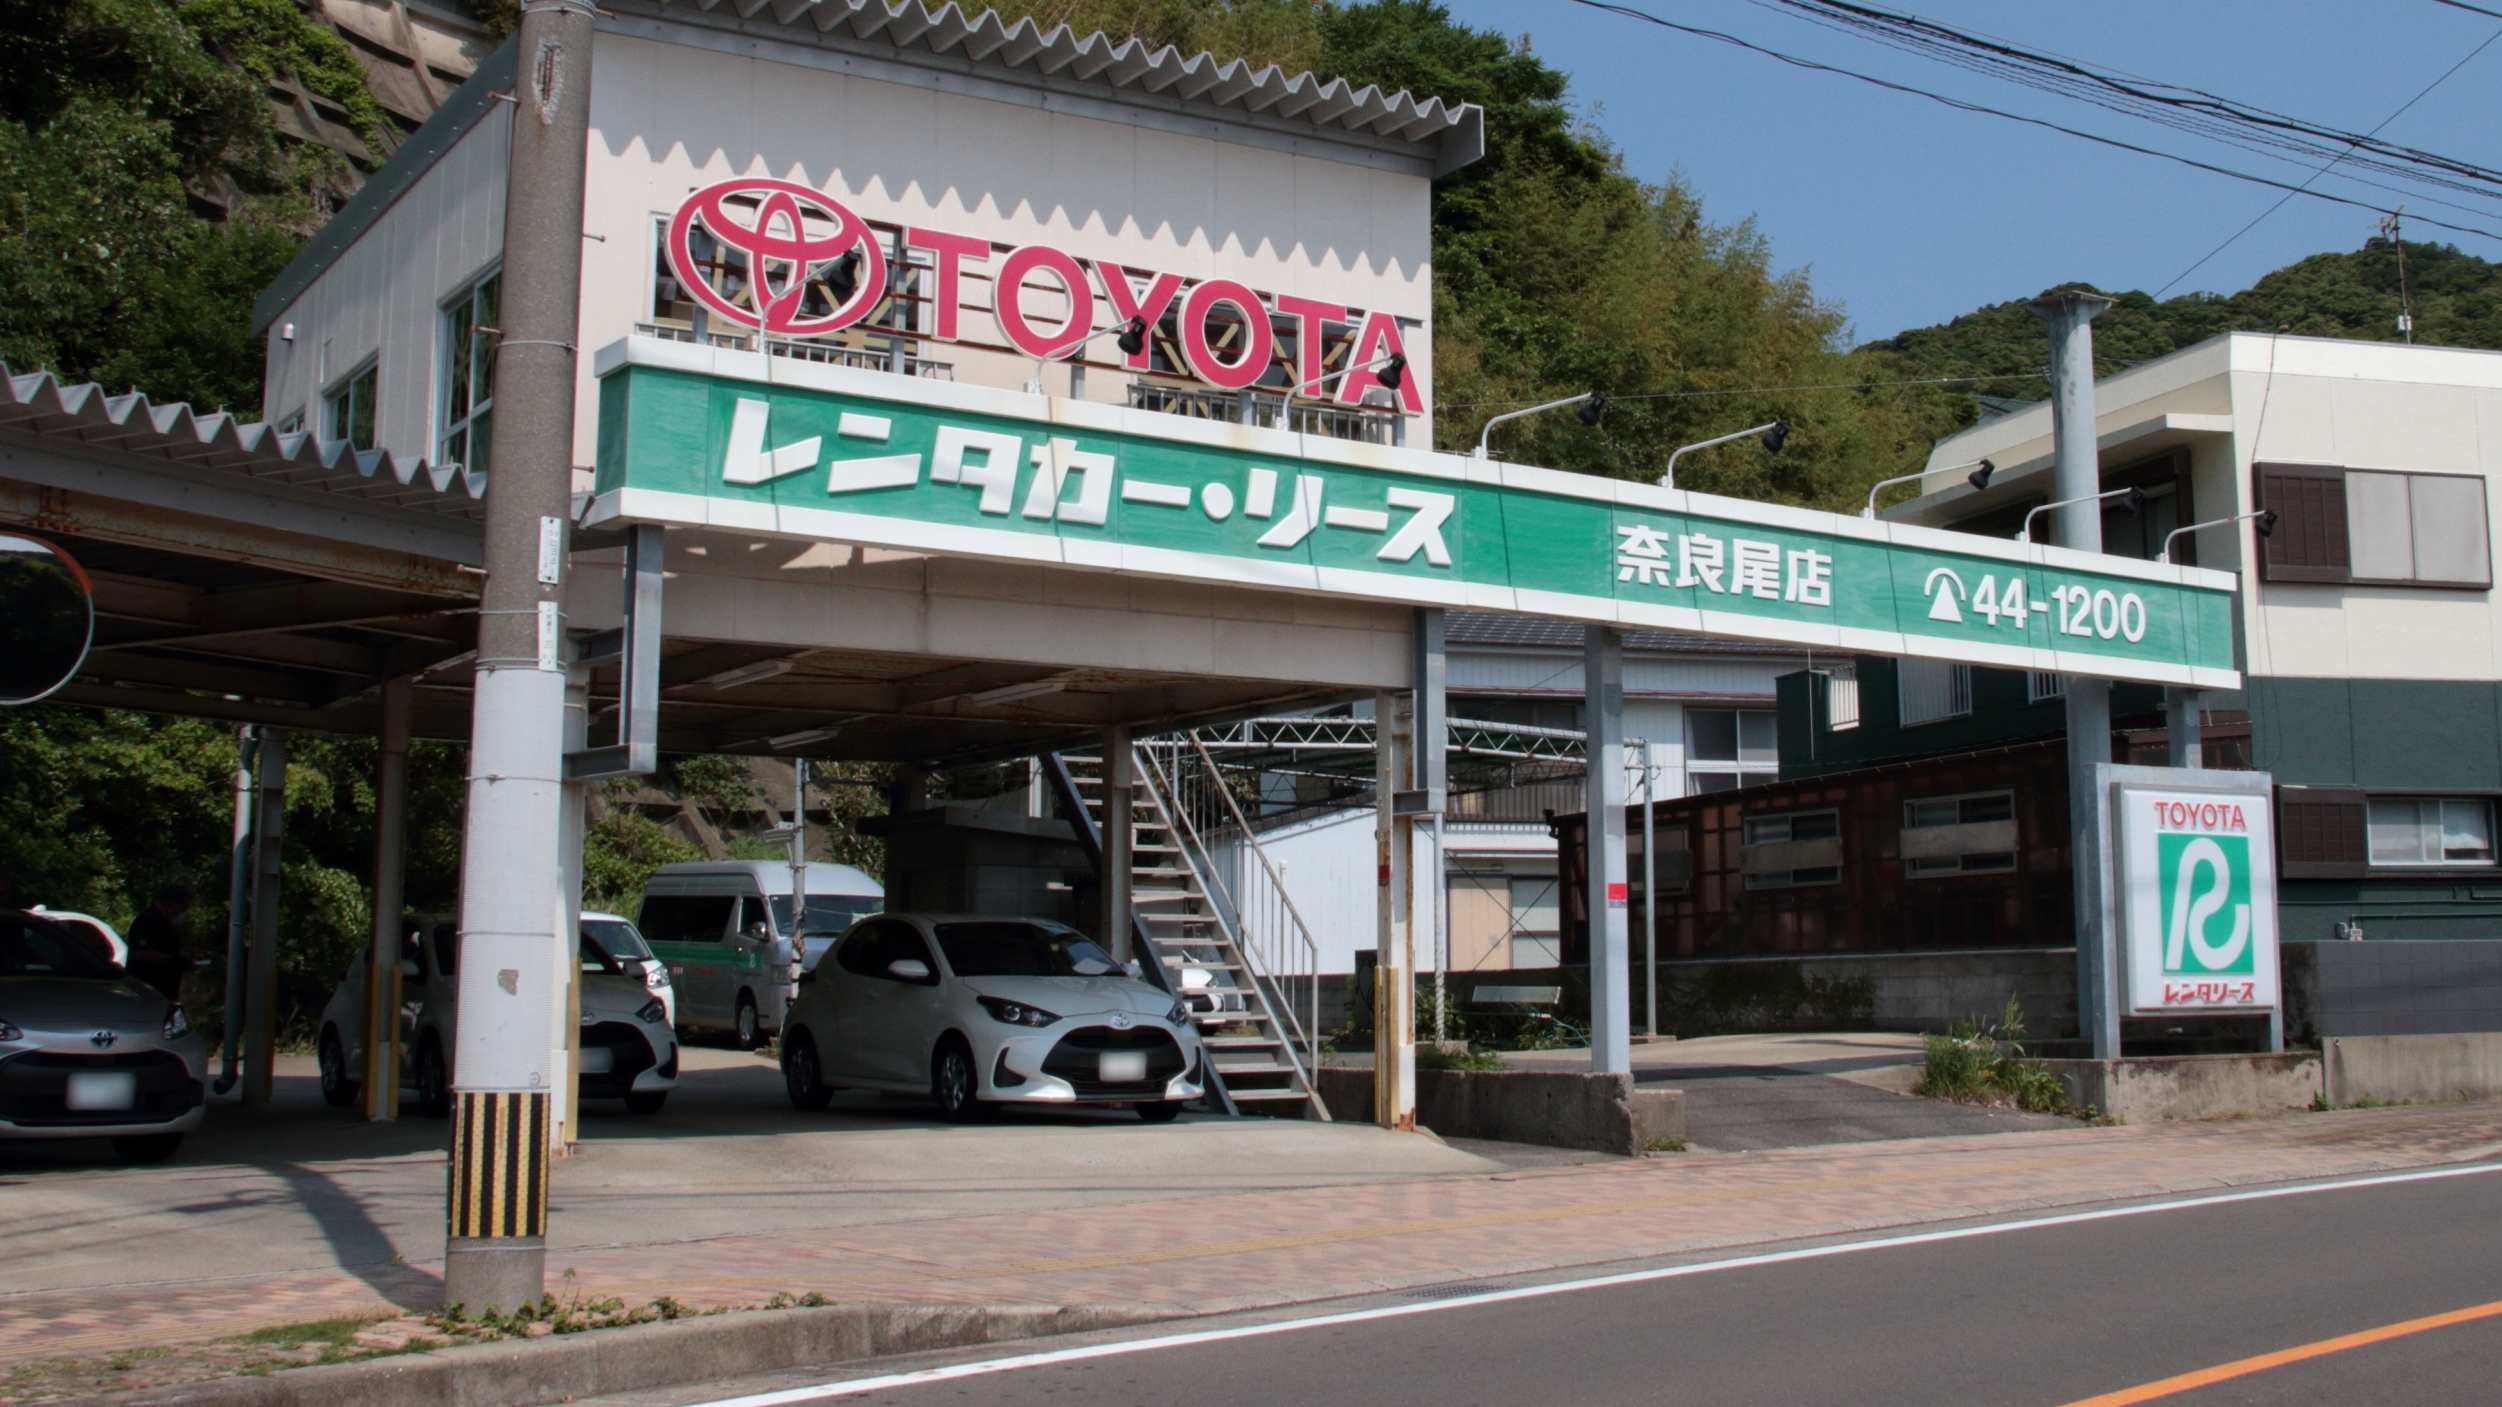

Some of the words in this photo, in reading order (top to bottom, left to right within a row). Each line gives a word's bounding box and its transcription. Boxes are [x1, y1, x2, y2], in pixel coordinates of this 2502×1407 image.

[905, 226, 1425, 415] TOYOTA
[723, 398, 1455, 566] レンタカー・リース
[1617, 524, 1832, 606] 奈良尾店
[1972, 574, 2146, 643] 44-1200
[2154, 801, 2246, 828] TOYOTA
[2162, 982, 2255, 1003] レンタリース
